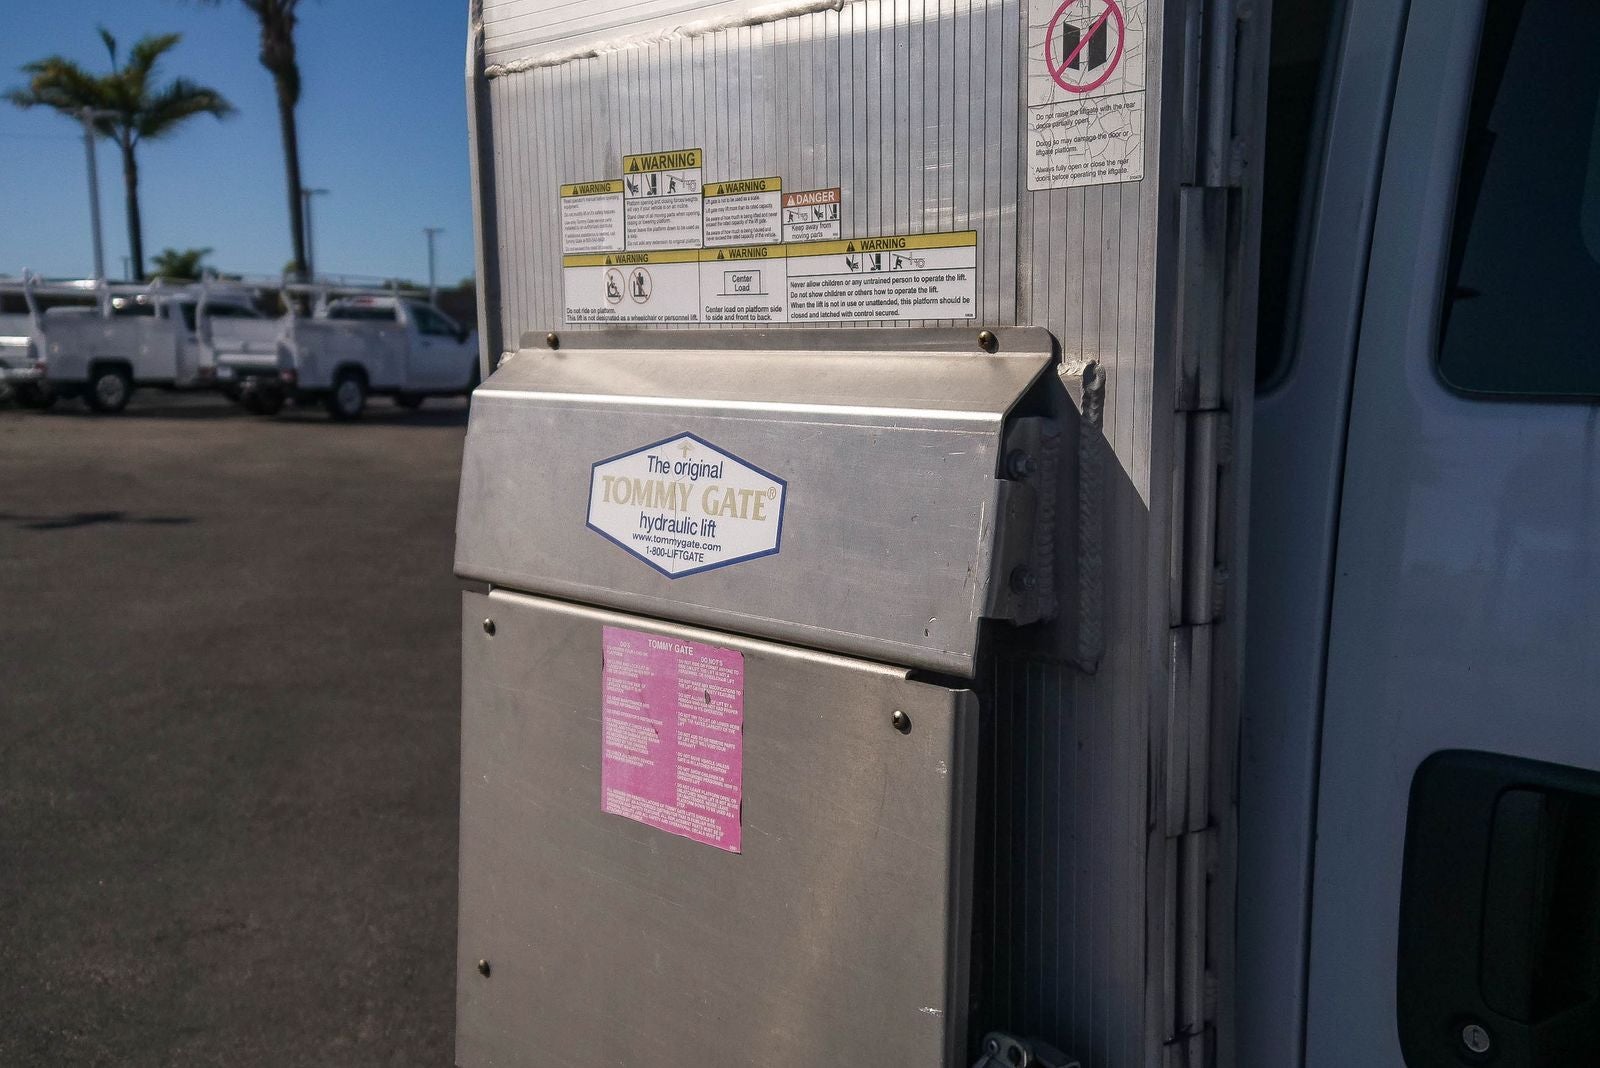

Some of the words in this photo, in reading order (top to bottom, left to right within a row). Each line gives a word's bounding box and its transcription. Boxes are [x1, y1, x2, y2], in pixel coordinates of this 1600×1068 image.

[641, 152, 695, 170] WARNING
[580, 183, 610, 194] WARNING
[726, 180, 766, 193] WARNING
[796, 191, 835, 204] DANGER
[792, 224, 804, 232] Keep
[792, 233, 809, 241] moving
[860, 238, 906, 250] WARNING
[615, 254, 649, 263] WARNING
[729, 248, 767, 258] WARNING
[732, 275, 752, 283] Center
[821, 279, 843, 287] children
[863, 277, 890, 285] untrained
[921, 275, 944, 284] operate
[735, 284, 749, 292] Load
[894, 287, 917, 296] operate
[913, 298, 938, 306] platform
[746, 306, 768, 314] platform
[647, 455, 670, 474] The
[674, 459, 723, 481] original
[602, 475, 694, 512] TOMMY
[639, 511, 698, 535] hydraulic
[700, 519, 716, 538] lift
[632, 532, 721, 552] www.tommygate.com
[646, 546, 704, 563] 1-800-LIFTGATE
[648, 639, 673, 651] TOMMY
[674, 643, 694, 656] GATE
